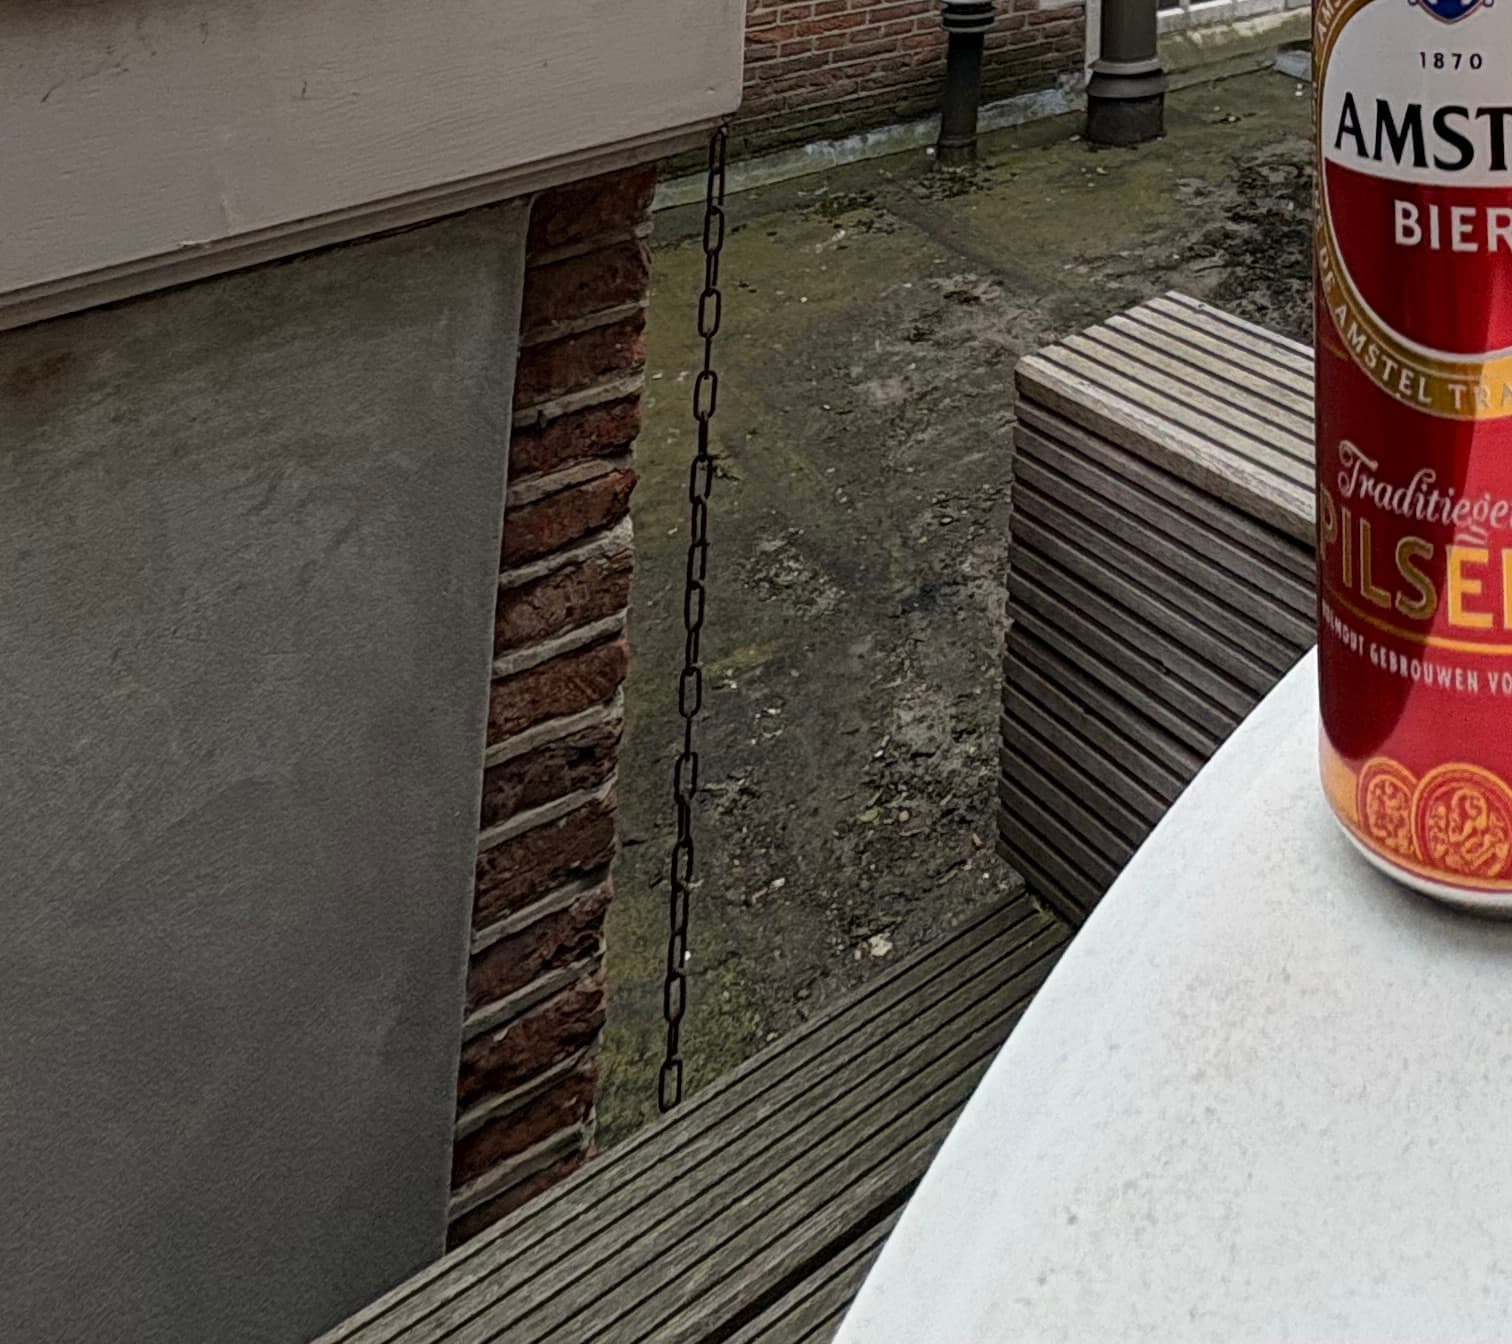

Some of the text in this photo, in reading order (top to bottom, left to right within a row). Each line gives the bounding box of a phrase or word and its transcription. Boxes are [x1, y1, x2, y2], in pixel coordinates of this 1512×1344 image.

[1419, 51, 1484, 71] 1870
[1334, 304, 1432, 405] AMSTEL
[1369, 643, 1479, 692] GEBROUWEN
